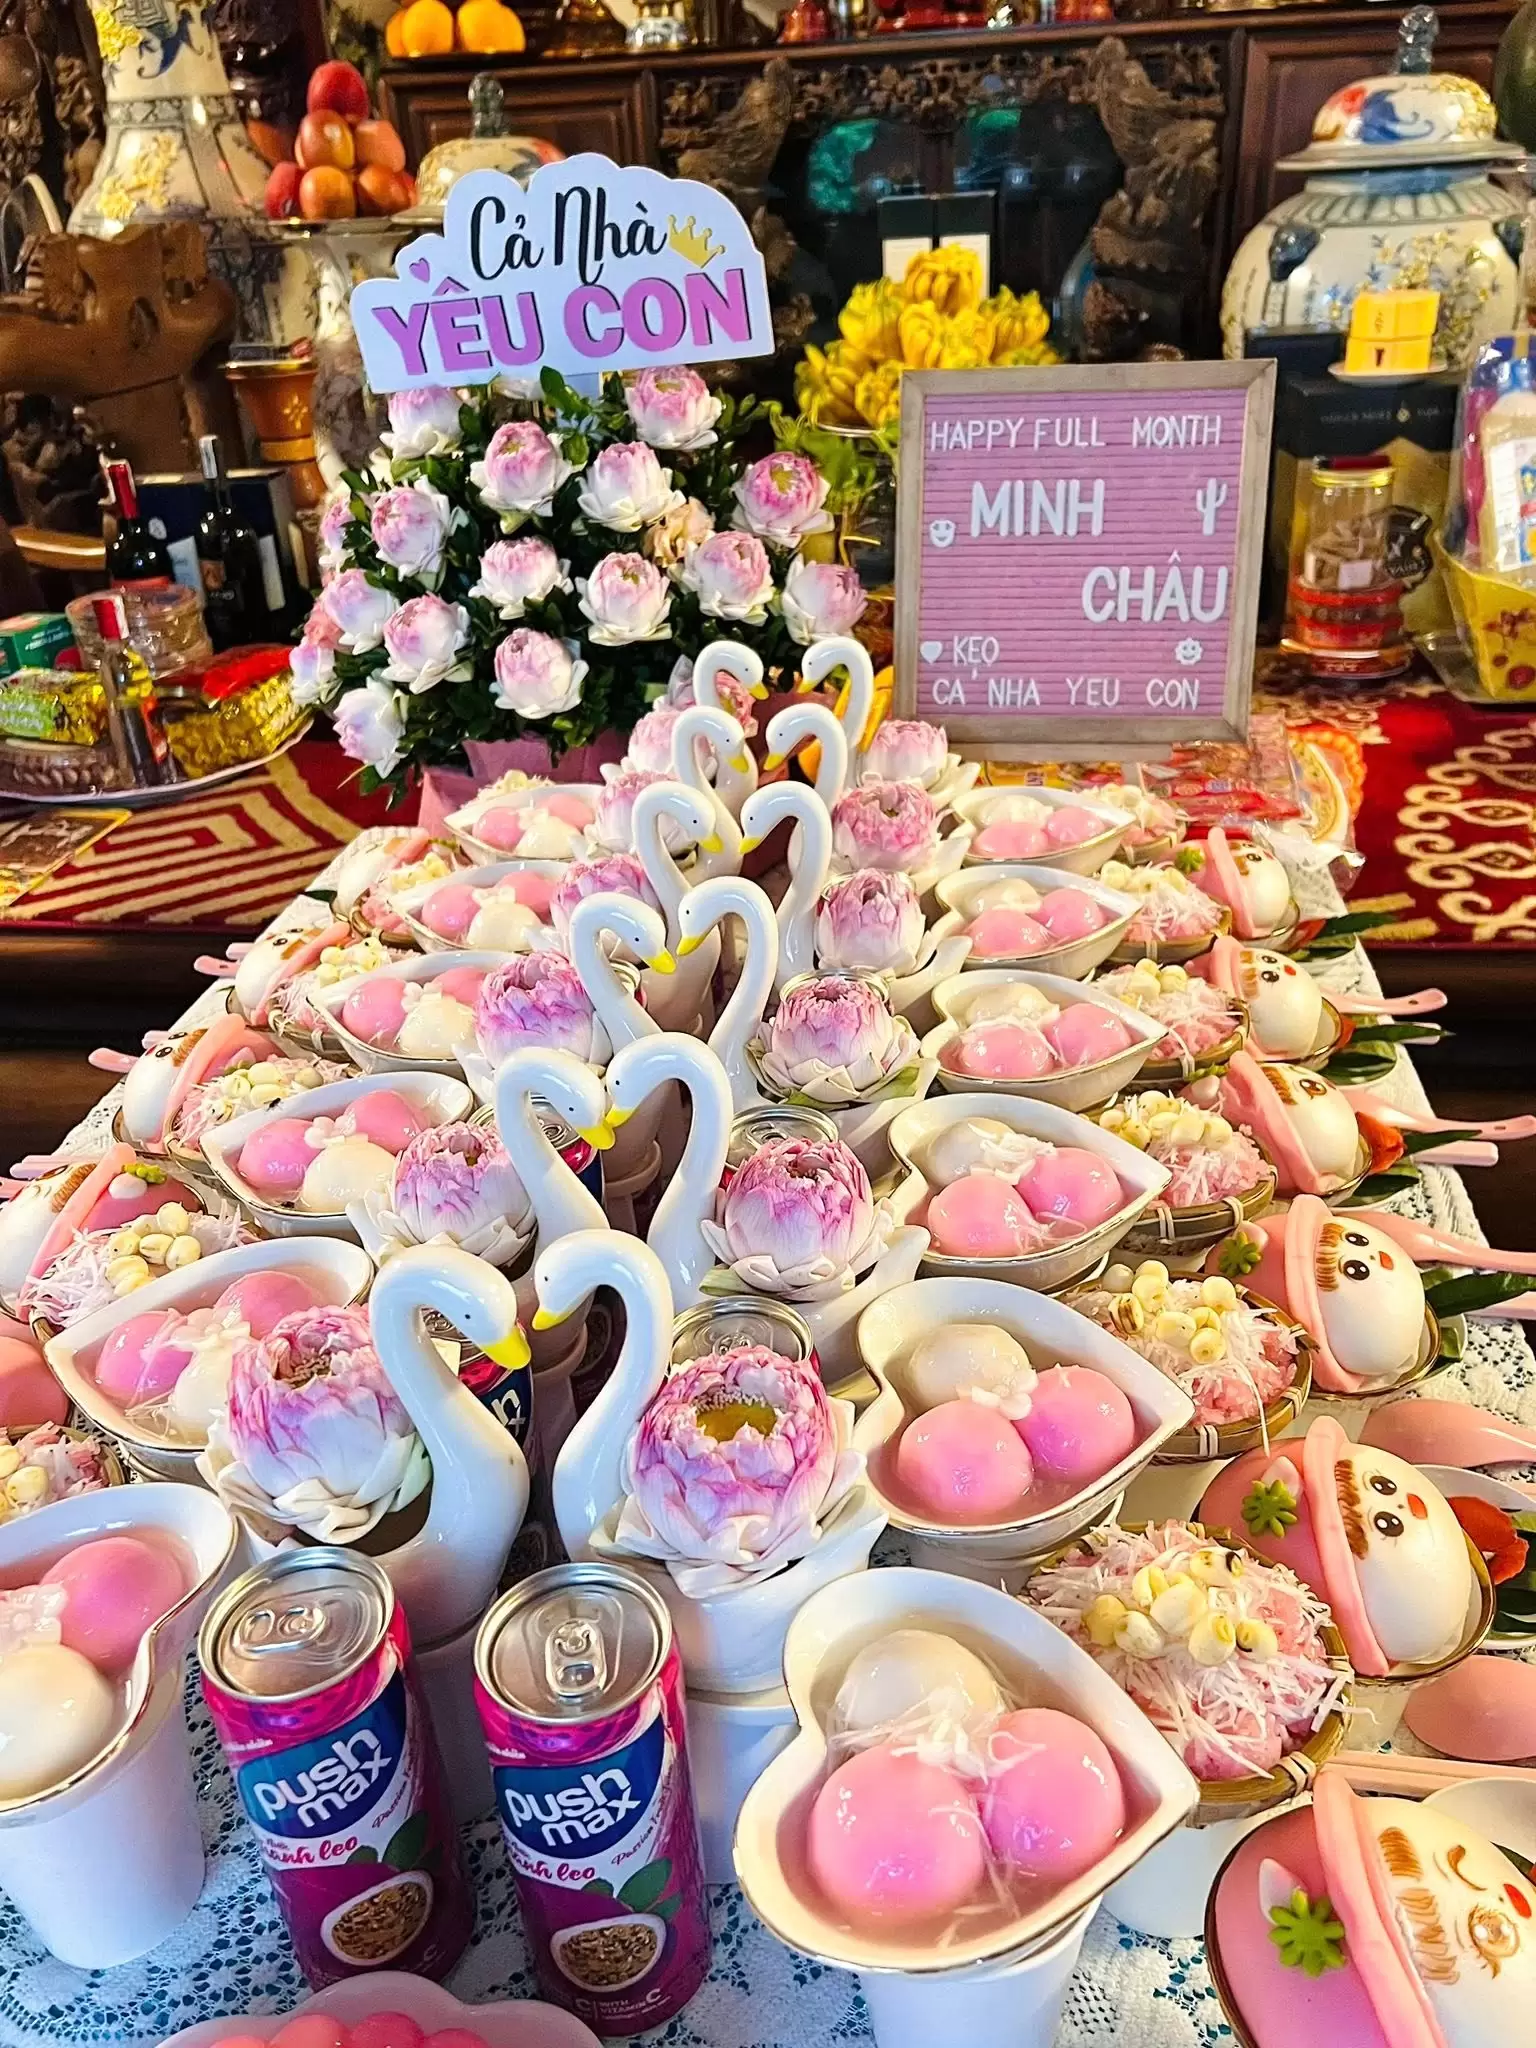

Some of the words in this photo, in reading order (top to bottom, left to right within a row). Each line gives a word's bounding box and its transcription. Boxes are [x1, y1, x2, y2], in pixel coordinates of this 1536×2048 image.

[470, 196, 544, 281] Cả
[553, 185, 667, 286] Nhà
[372, 276, 545, 376] YÊU
[563, 268, 752, 359] CON
[931, 417, 1024, 452] HAPPY
[1033, 416, 1106, 451] FULL
[1132, 414, 1221, 448] MONTH
[969, 478, 1105, 538] MINH
[1081, 549, 1228, 623] CHÂU
[988, 677, 1040, 709] NHA
[1065, 676, 1120, 706] YEU
[1145, 677, 1199, 710] CON
[253, 1728, 380, 1821] push
[296, 1744, 393, 1829] max
[504, 1768, 631, 1828] push
[541, 1787, 641, 1847] max
[319, 1836, 358, 1860] leo
[557, 1862, 595, 1881] leo
[645, 1987, 662, 2004] C
